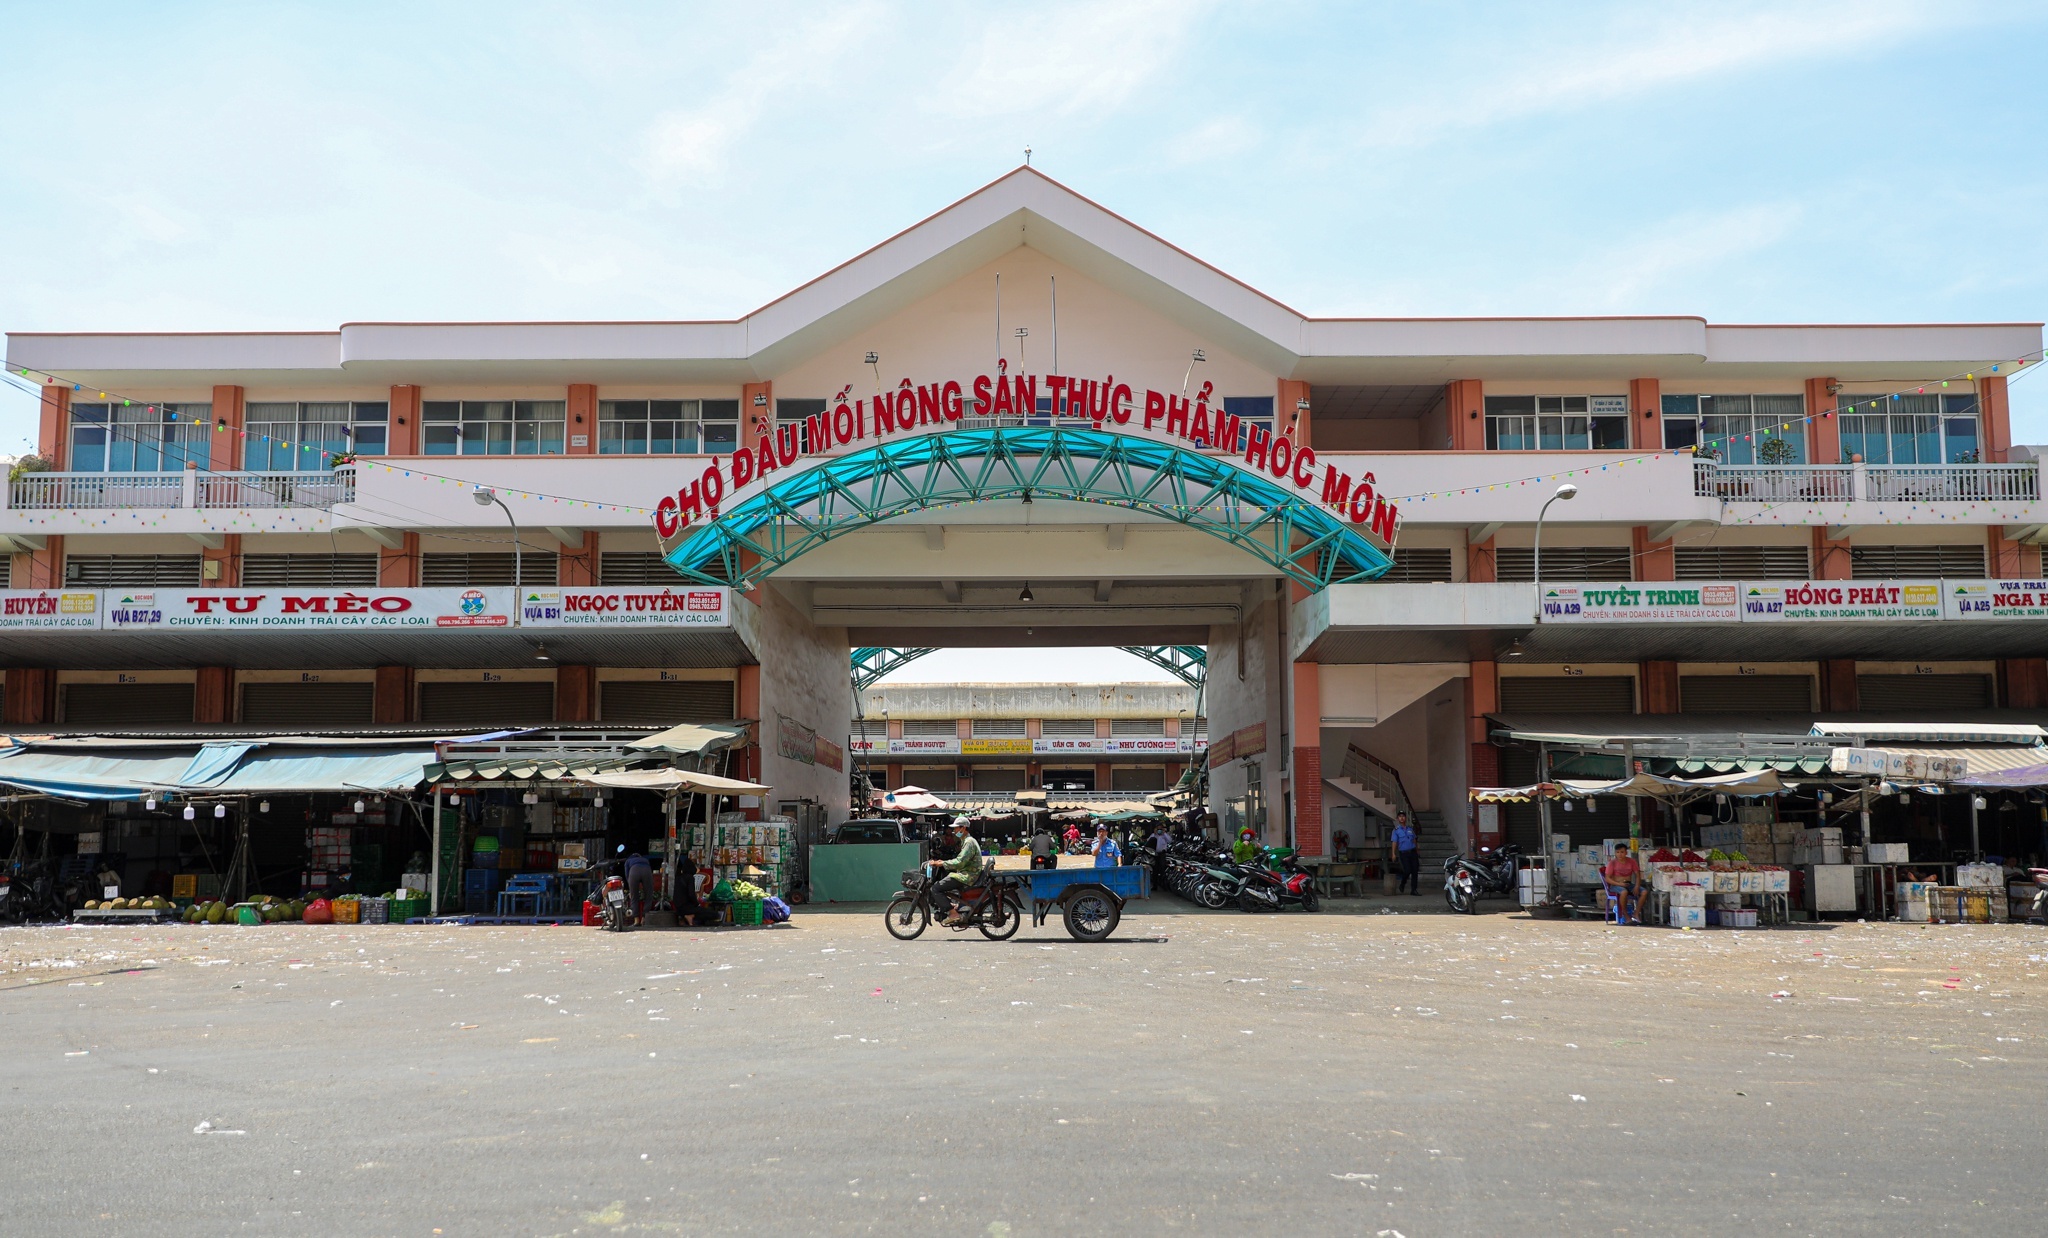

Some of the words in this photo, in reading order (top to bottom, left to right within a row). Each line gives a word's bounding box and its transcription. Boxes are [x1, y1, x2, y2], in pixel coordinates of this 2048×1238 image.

[655, 455, 724, 539] CHỢ
[731, 415, 798, 491] ĐẦU
[805, 384, 865, 454] MỐI
[873, 378, 964, 437] NÔNG
[973, 358, 1036, 416] SẢN
[1046, 374, 1132, 430] THỰC
[1143, 380, 1241, 455] PHẨM
[1245, 426, 1316, 489] HÓC
[1321, 471, 1398, 545] MÔN
[1785, 582, 1843, 604] HỒNG
[1848, 583, 1899, 604] PHÁT
[2000, 582, 2020, 591] VỰA
[187, 595, 266, 613] TƯ
[281, 592, 412, 614] MÈO
[565, 595, 619, 614] NGỌC
[623, 588, 685, 611] TUYỀN
[1645, 590, 1699, 605] TRINH
[1993, 593, 2034, 607] NGA
[1544, 601, 1562, 617] VỰA
[1564, 603, 1580, 614] A29
[1767, 602, 1782, 613] A27
[1784, 607, 1818, 617] CHUYÊN:
[1820, 609, 1837, 617] KINH
[1839, 609, 1865, 617] DOANH
[1868, 608, 1884, 616] TRÁI
[1904, 607, 1920, 616] CÁC
[1922, 609, 1938, 617] LOẠI
[1974, 601, 1990, 611] A25
[1993, 608, 2025, 616] CHUYÊN:
[112, 608, 130, 626] VỰA
[132, 610, 161, 625] B27,29
[525, 606, 541, 621] VỰA
[545, 608, 560, 618] B31
[563, 614, 598, 623] CHUYÊN:
[600, 615, 618, 623] KINH
[649, 614, 666, 622] TRÁI
[668, 614, 683, 622] CÂY
[686, 614, 701, 622] CÁC
[704, 615, 721, 623] LOẠI
[1583, 609, 1611, 618] CHUYÊN:
[1707, 609, 1720, 617] CÁC
[25, 617, 41, 626] TRÁI
[43, 617, 58, 626] CÂY
[60, 617, 76, 626] CÁC
[77, 618, 94, 627] LOẠI
[170, 615, 225, 625] CHUYÊN:
[229, 617, 259, 625] KINH
[263, 617, 305, 625] DOANH
[309, 615, 338, 625] TRÁI
[341, 615, 367, 625] CÂY
[371, 615, 397, 625] CÁC
[401, 616, 429, 627] LOẠI
